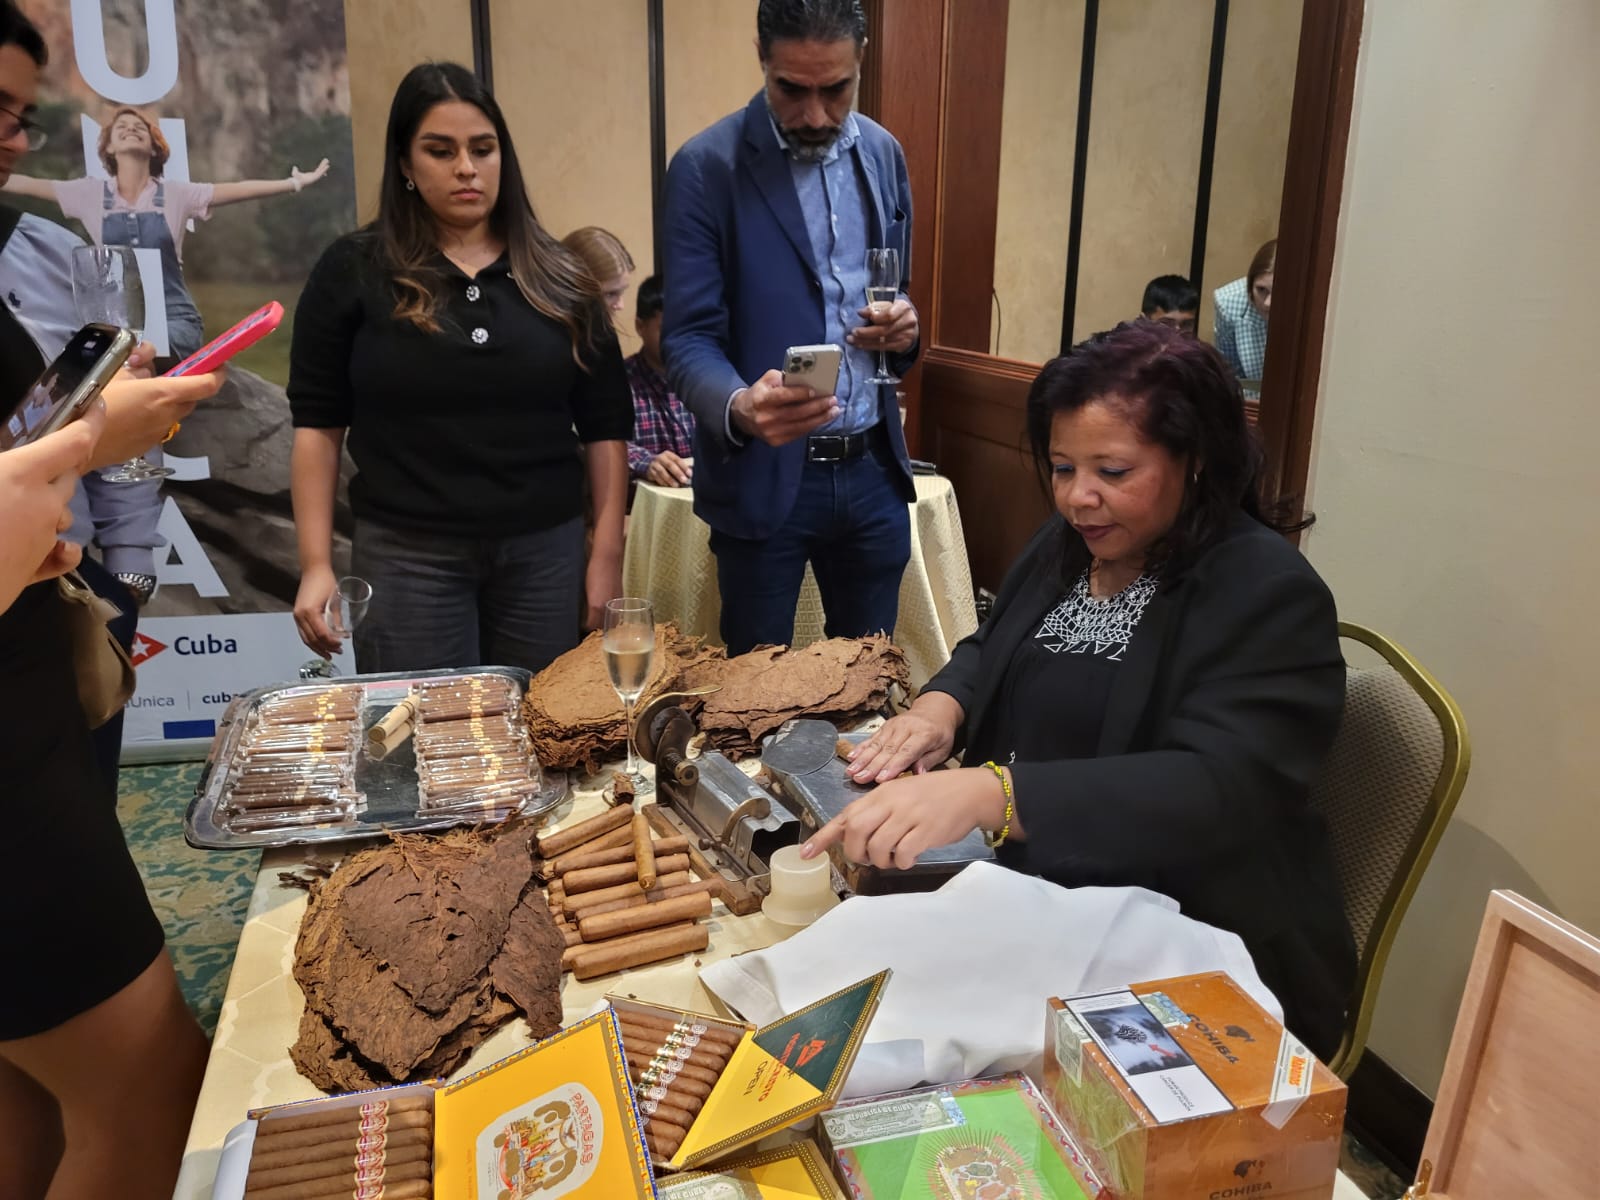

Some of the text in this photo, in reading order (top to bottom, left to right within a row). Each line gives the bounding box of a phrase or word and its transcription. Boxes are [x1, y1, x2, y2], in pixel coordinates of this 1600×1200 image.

[174, 634, 237, 655] Cuba
[202, 692, 239, 704] cub
[1187, 1013, 1240, 1064] COHIBA
[572, 1092, 594, 1165] PARTAGAS
[1209, 1181, 1272, 1200] COHIBA
